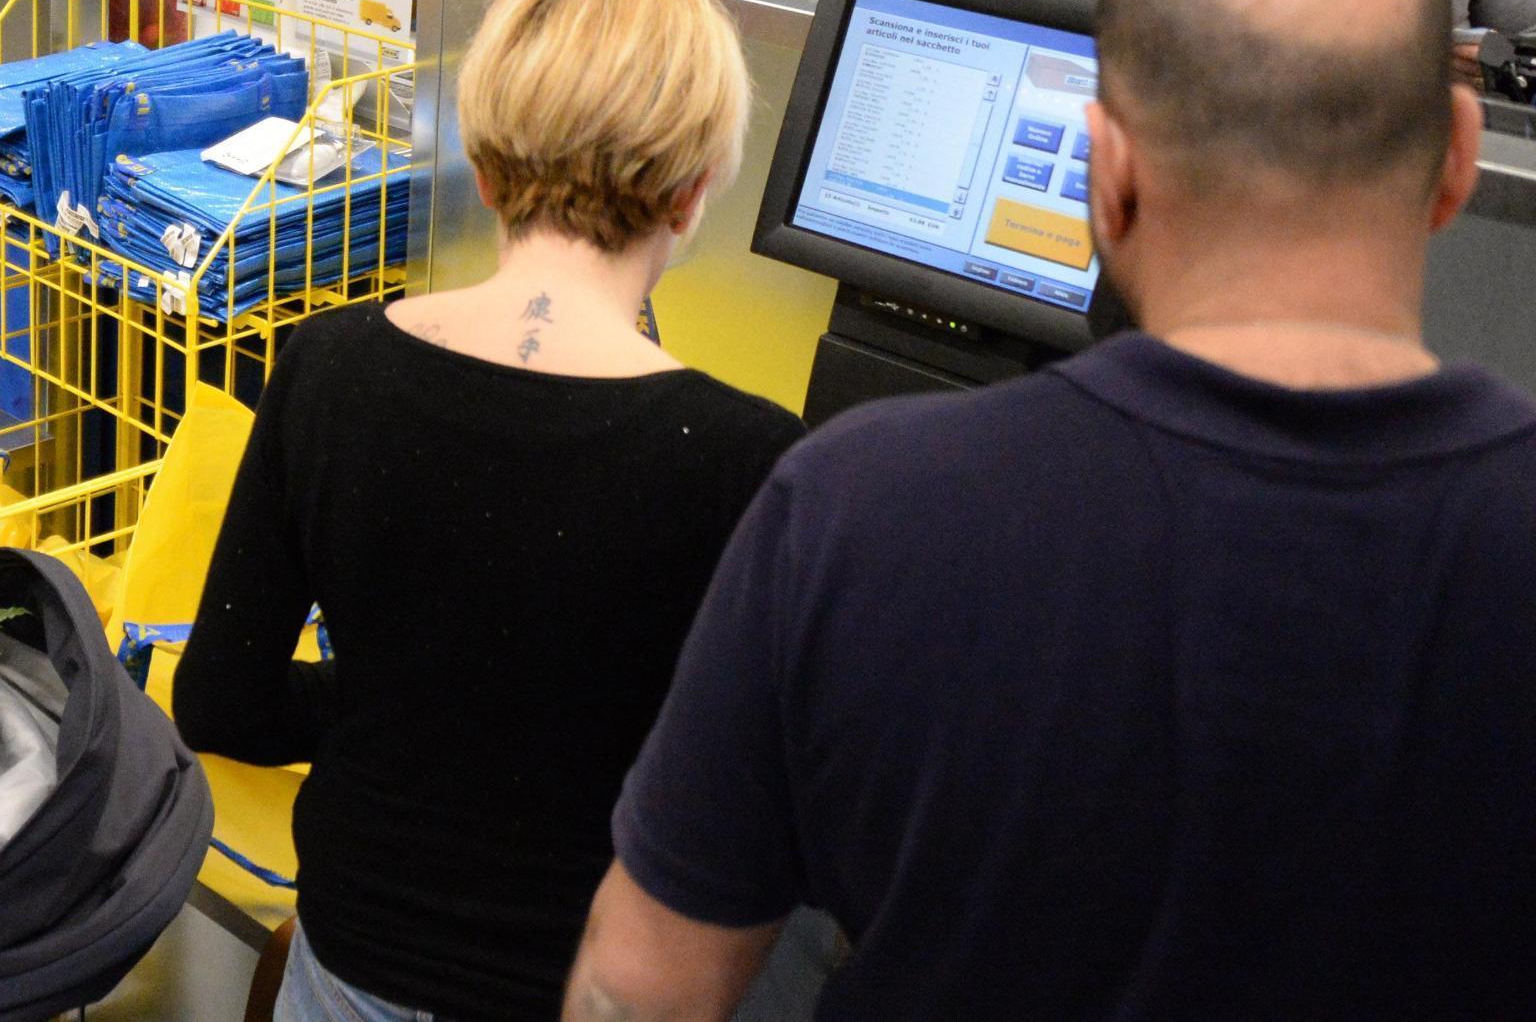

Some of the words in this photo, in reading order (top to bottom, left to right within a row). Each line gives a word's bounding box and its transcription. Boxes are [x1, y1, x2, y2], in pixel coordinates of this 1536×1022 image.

[866, 27, 898, 41] articoli
[900, 33, 914, 45] nel
[916, 37, 961, 55] sacchetto
[868, 16, 914, 34] Scansiona
[924, 30, 963, 45] inserisci
[972, 39, 990, 51] tuoi
[1056, 233, 1081, 247] paga
